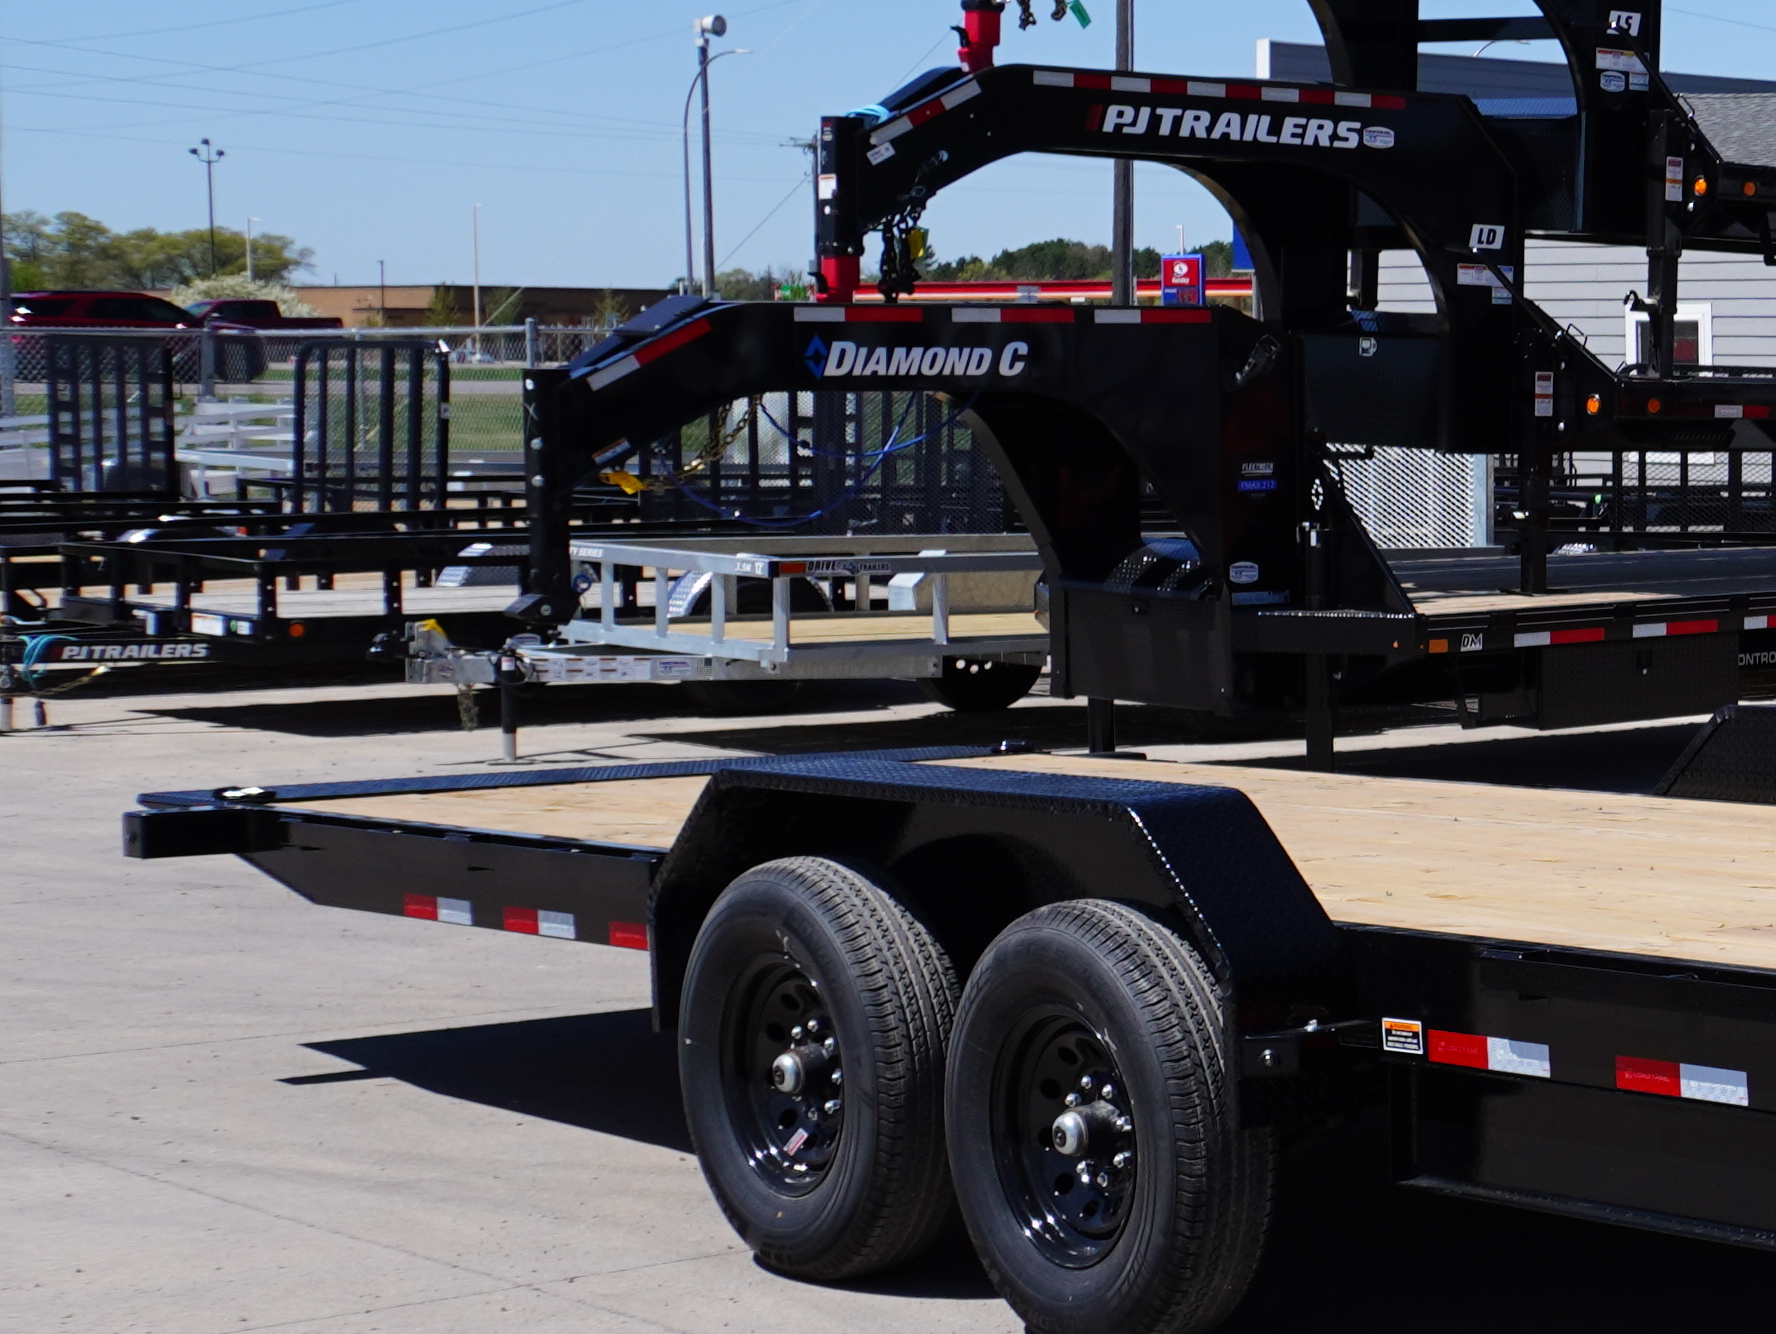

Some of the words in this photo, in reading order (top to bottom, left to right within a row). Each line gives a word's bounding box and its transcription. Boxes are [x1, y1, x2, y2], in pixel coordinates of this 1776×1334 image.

[1102, 105, 1151, 134] PJ
[1155, 108, 1362, 149] TRAILERS
[1476, 227, 1498, 246] LD
[823, 341, 993, 377] DIAMOND
[998, 341, 1029, 377] C
[61, 645, 87, 660] PJ
[90, 643, 209, 659] TRAILERS
